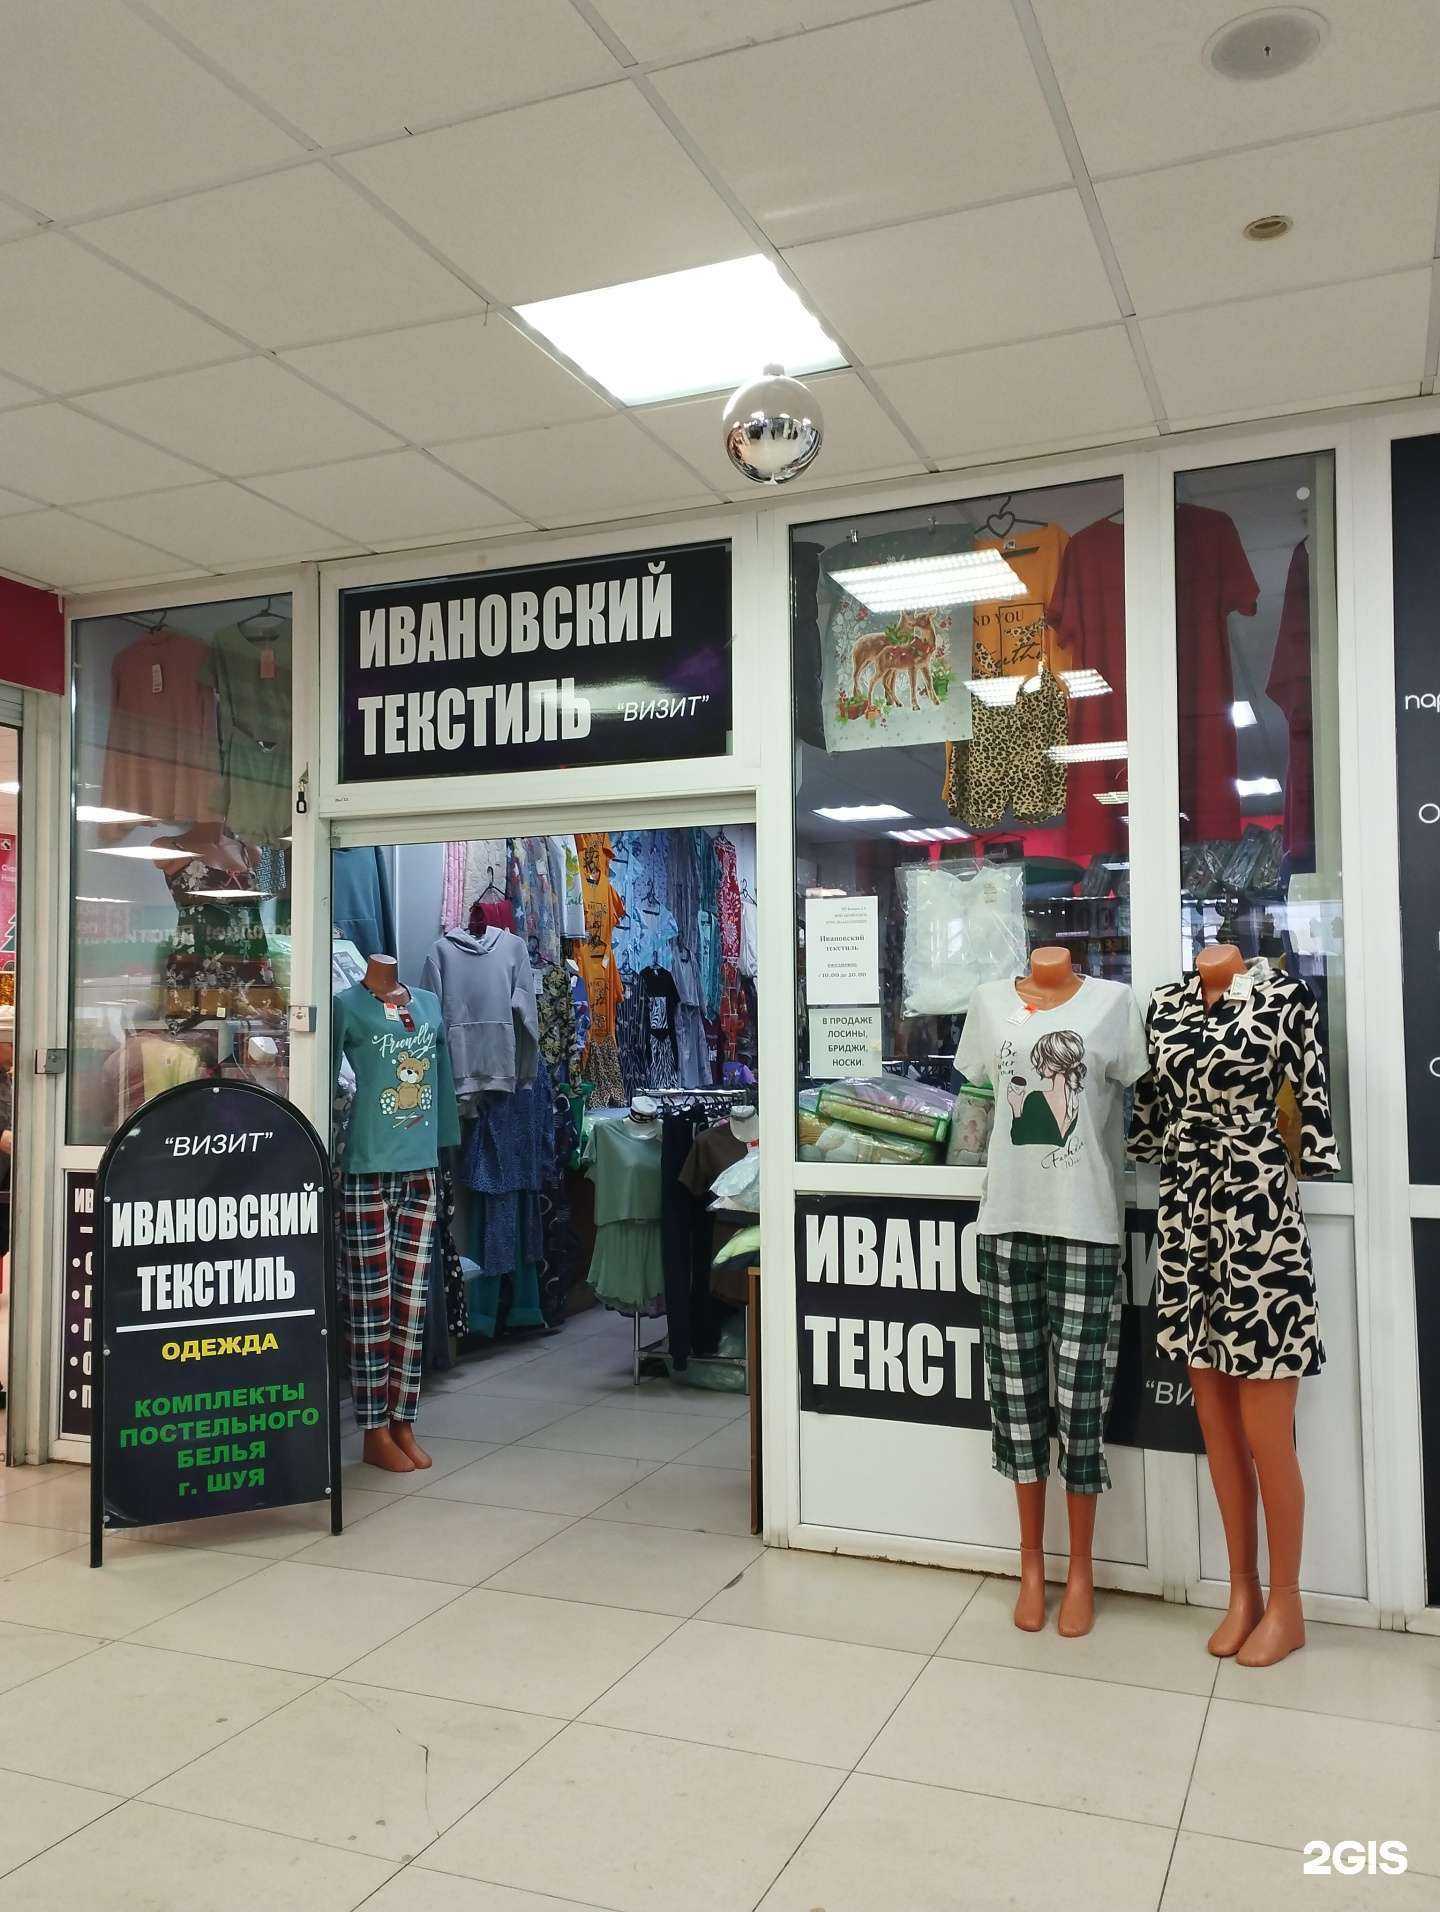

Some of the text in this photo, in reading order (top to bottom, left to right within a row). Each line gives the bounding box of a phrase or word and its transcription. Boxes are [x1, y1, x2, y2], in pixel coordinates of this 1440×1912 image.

[358, 560, 673, 669] ИВАНОВСКИЙ
[973, 610, 1024, 626] ND YOU
[358, 677, 592, 756] ТЕКСТИЛЬ
[822, 1016, 873, 1026] В ПРОДАЖЕ
[827, 1030, 868, 1039] ЛОСИНЫ,
[372, 1022, 437, 1059] Friendly
[111, 1182, 319, 1248] ИВАНОВСКИЙ
[136, 1256, 296, 1311] ТЕКСТИЛЬ
[161, 1332, 279, 1362] ОДЕЖДА
[804, 1315, 991, 1401] ТЕКСТ
[134, 1382, 305, 1418] КОМПЛЕКТЫ
[119, 1407, 320, 1448] ПОСТЕЛЬНОГО
[177, 1440, 266, 1469] БЕЛЬЯ
[178, 1468, 265, 1496] г. ШУЯ
